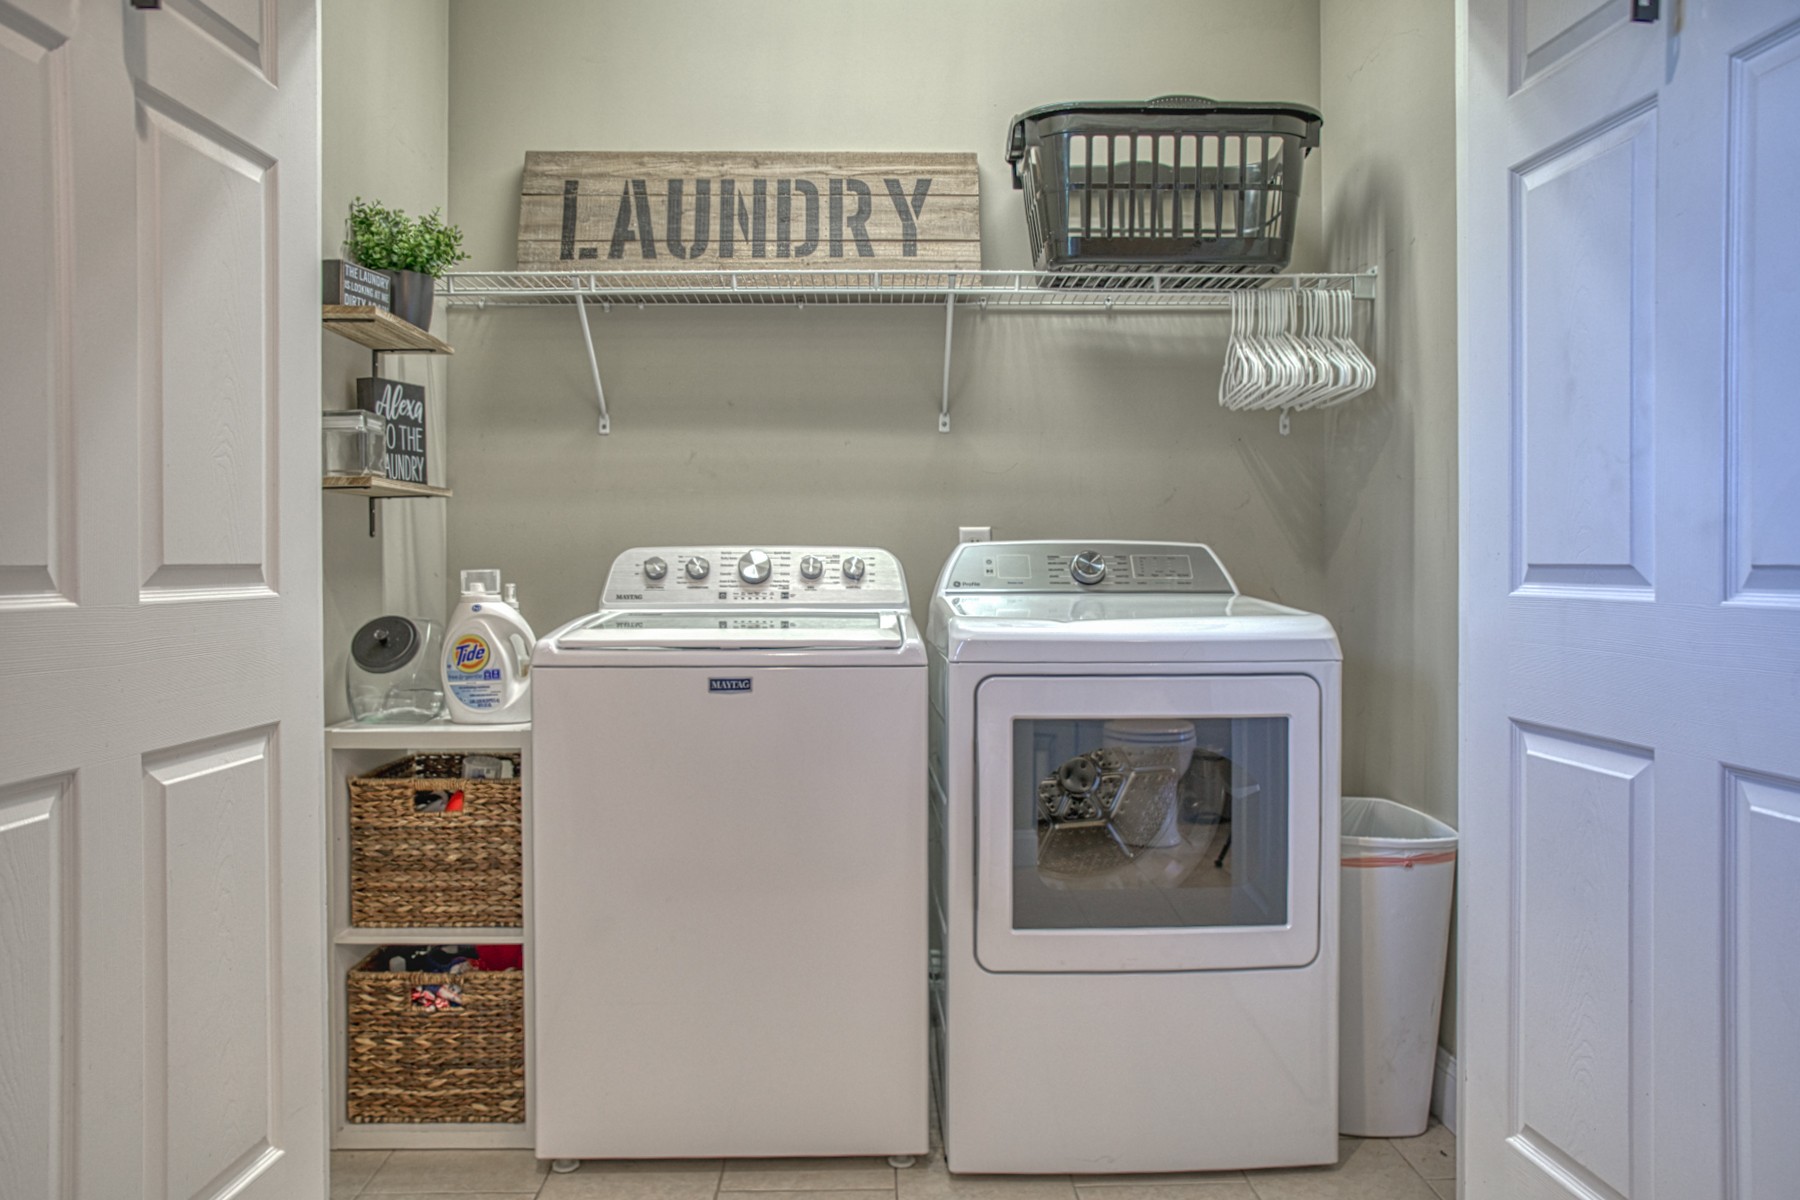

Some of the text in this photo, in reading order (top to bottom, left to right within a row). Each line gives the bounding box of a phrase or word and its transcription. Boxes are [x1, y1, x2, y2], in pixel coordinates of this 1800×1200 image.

[559, 178, 933, 260] LAUNDRY
[345, 263, 390, 290] THE LAUNDRY
[351, 281, 374, 298] LOOKING
[375, 384, 423, 423] Alexa
[398, 425, 424, 453] THE
[385, 453, 424, 482] AUNDRY
[455, 644, 486, 666] Tide
[711, 680, 750, 689] MAYTAG
